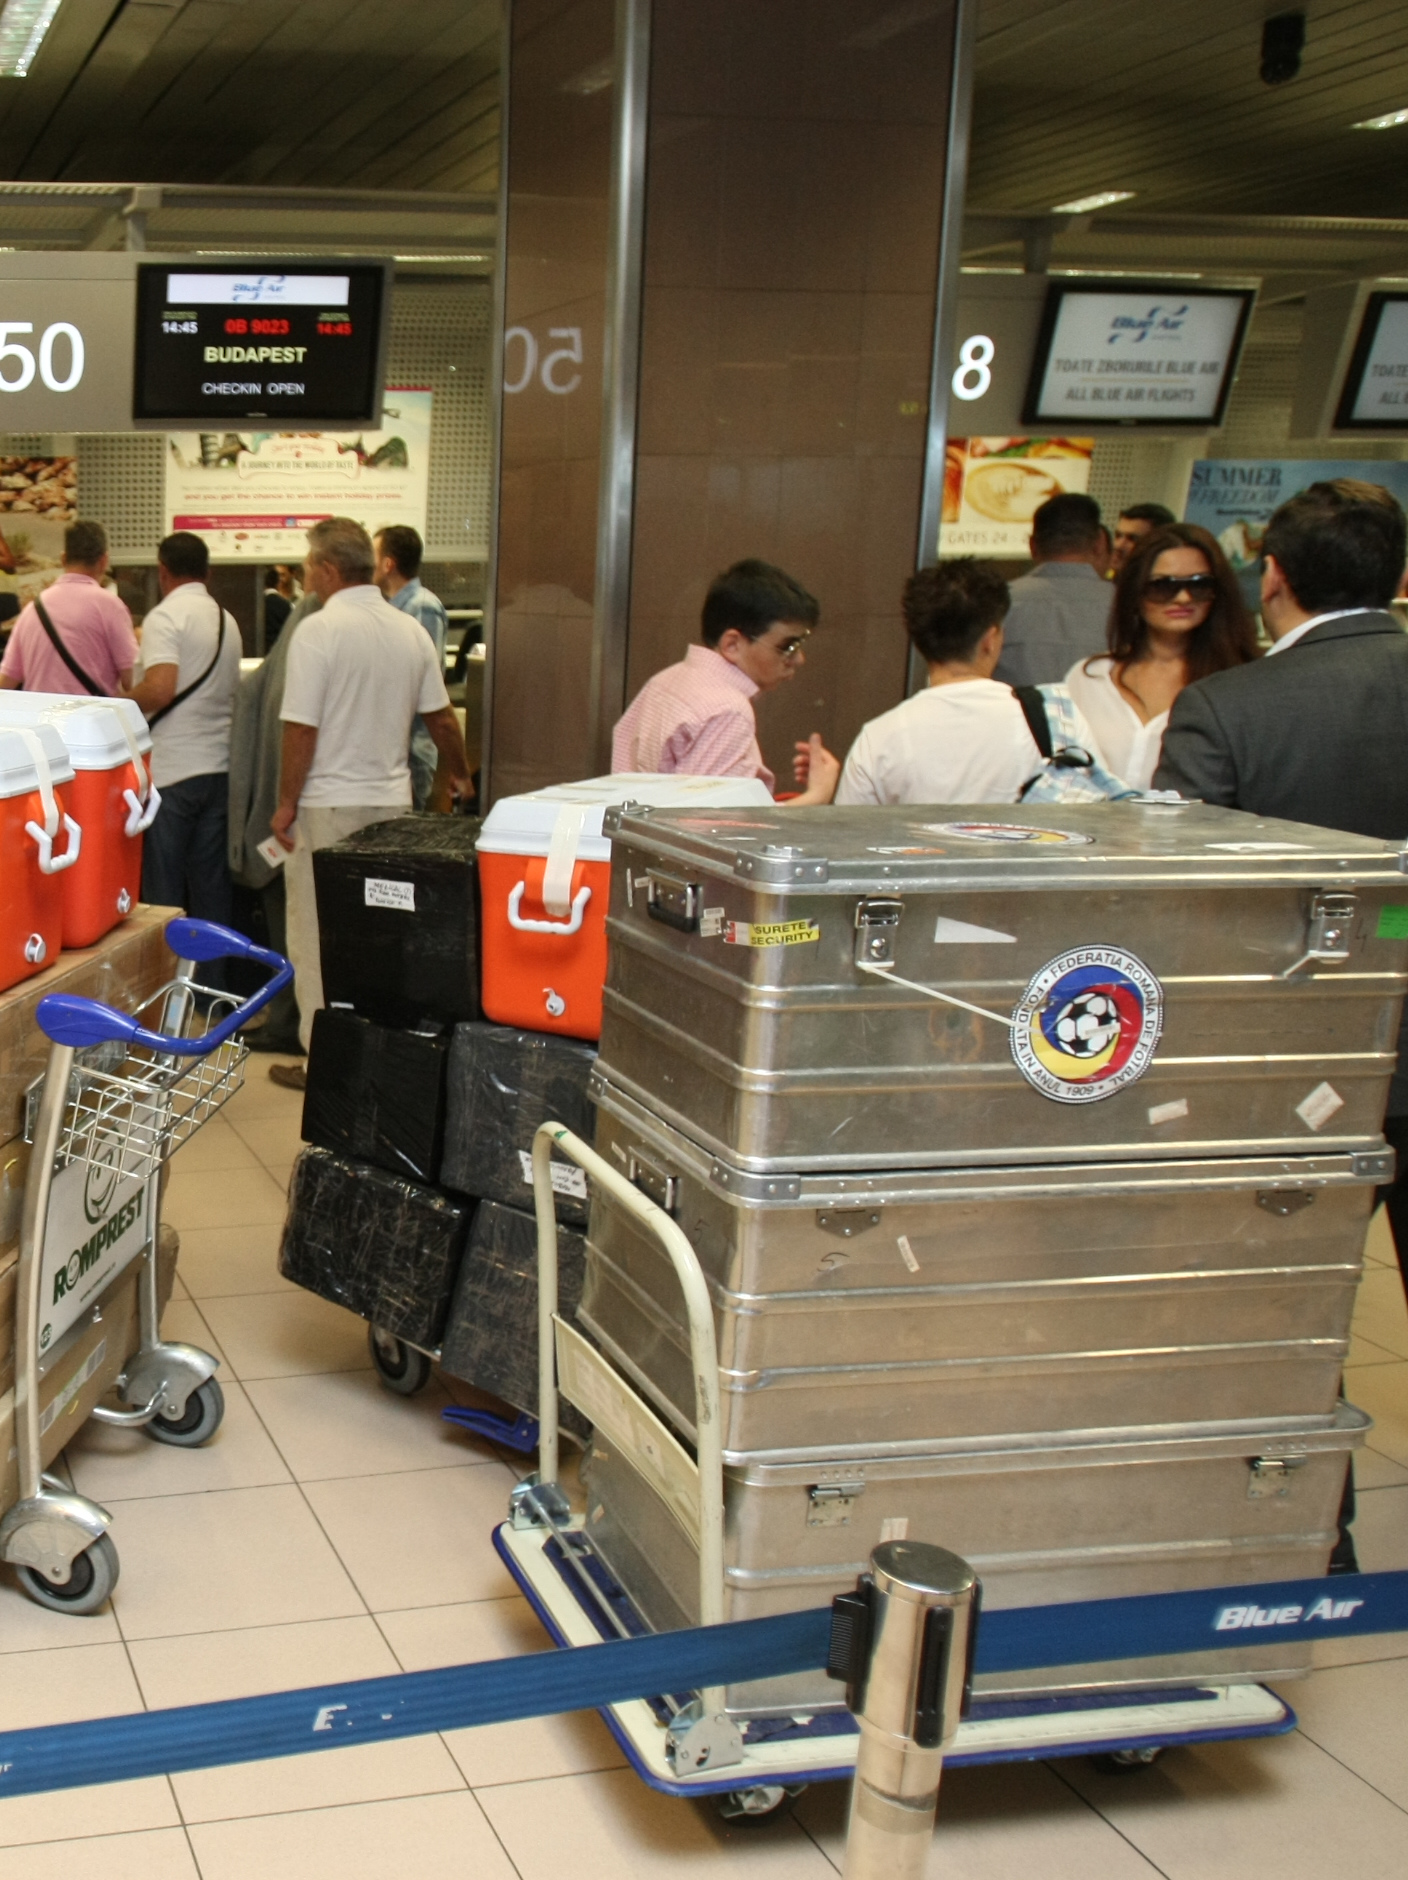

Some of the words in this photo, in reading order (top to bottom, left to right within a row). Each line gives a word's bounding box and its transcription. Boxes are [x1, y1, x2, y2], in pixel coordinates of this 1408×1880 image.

[162, 321, 198, 334] 14:45
[251, 319, 290, 335] 9023
[317, 322, 352, 335] 14:45
[204, 346, 307, 363] BUDAPEST
[952, 334, 995, 401] 8
[202, 382, 262, 395] CHECKIN
[266, 382, 305, 395] OPEN
[1192, 466, 1281, 486] SUMMER
[754, 921, 807, 936] SURETE
[750, 931, 813, 947] SECURITY
[1050, 952, 1123, 979] FEDERATIA
[1124, 962, 1156, 1017] ROMANA
[1141, 1019, 1156, 1039] DE
[1108, 1041, 1149, 1087] FOTBAL
[1021, 1052, 1035, 1068] IN
[1033, 1068, 1062, 1094] ANUL
[1065, 1084, 1095, 1097] 1909
[53, 1186, 145, 1306] ROMPREST
[1215, 1604, 1303, 1631] Blue
[1303, 1598, 1365, 1622] Air
